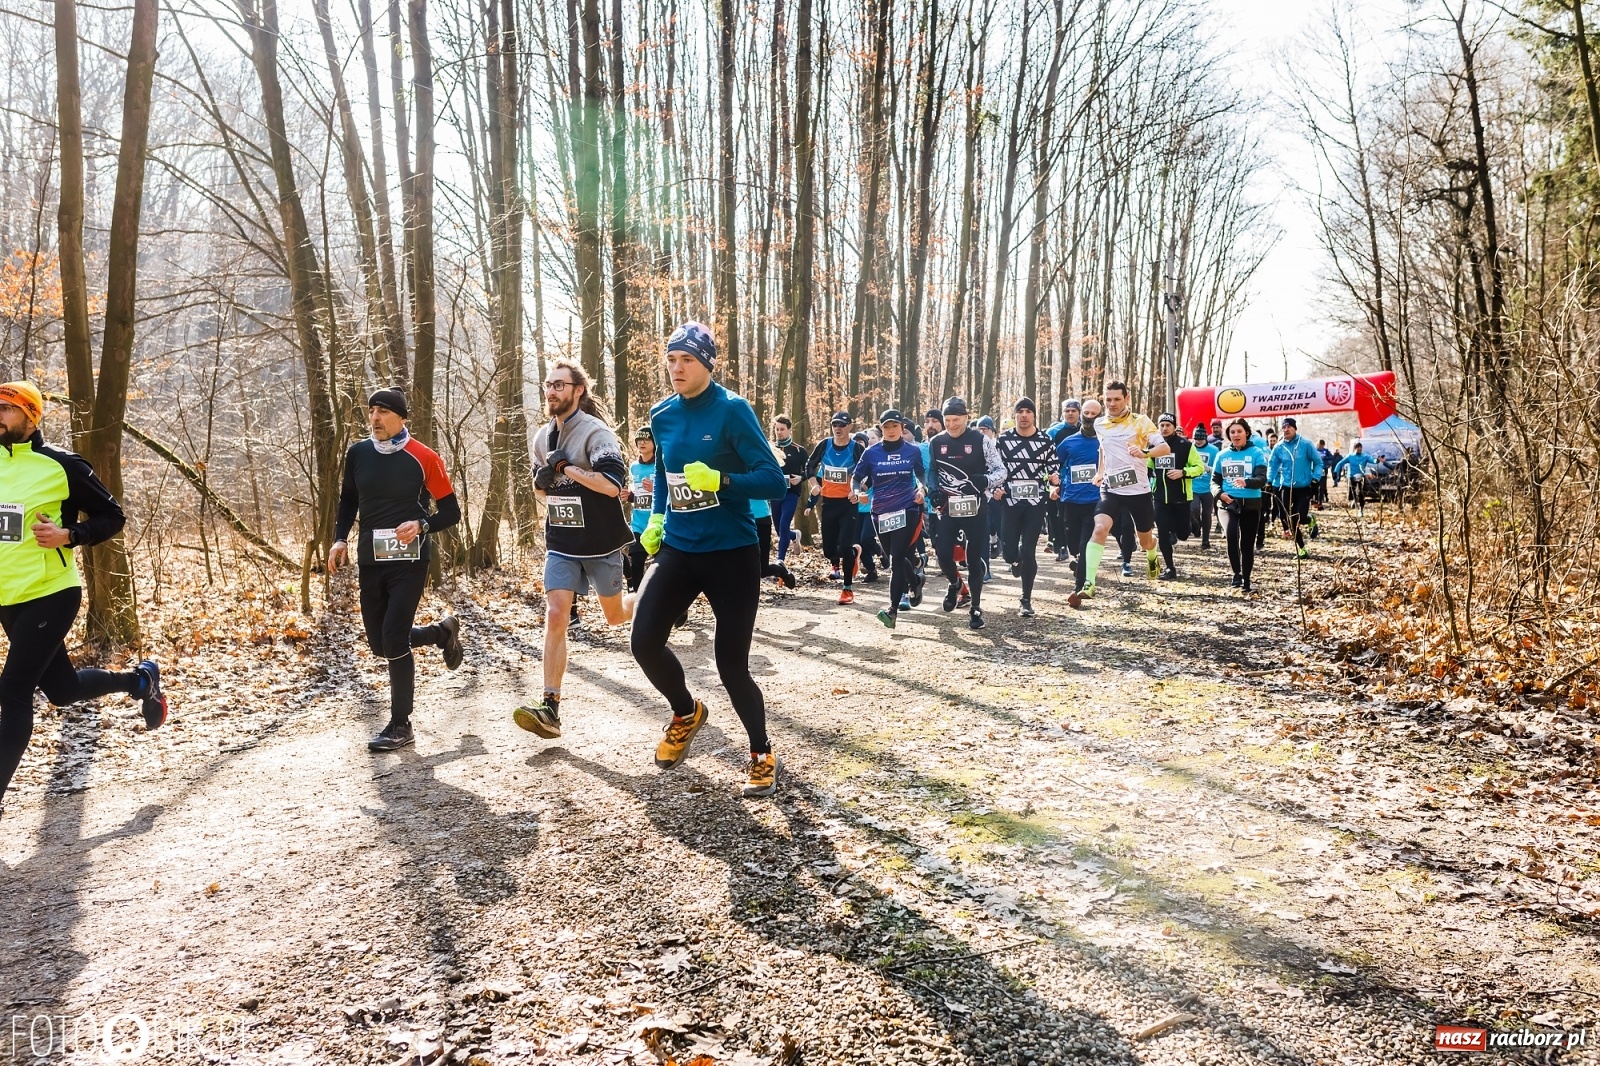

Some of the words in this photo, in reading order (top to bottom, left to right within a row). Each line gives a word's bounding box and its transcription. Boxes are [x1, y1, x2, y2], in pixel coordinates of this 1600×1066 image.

[1272, 384, 1296, 392] BIEG
[1252, 392, 1316, 403] TWARDZIELA
[1260, 402, 1310, 412] RACIBÓRZ
[1077, 470, 1091, 478] 152
[1225, 466, 1239, 474] 126
[829, 471, 842, 480] 148
[1114, 472, 1131, 483] 162
[1016, 485, 1034, 494] 047
[636, 496, 649, 505] 007
[954, 502, 971, 511] 081
[554, 506, 574, 518] 153
[884, 516, 901, 527] 063
